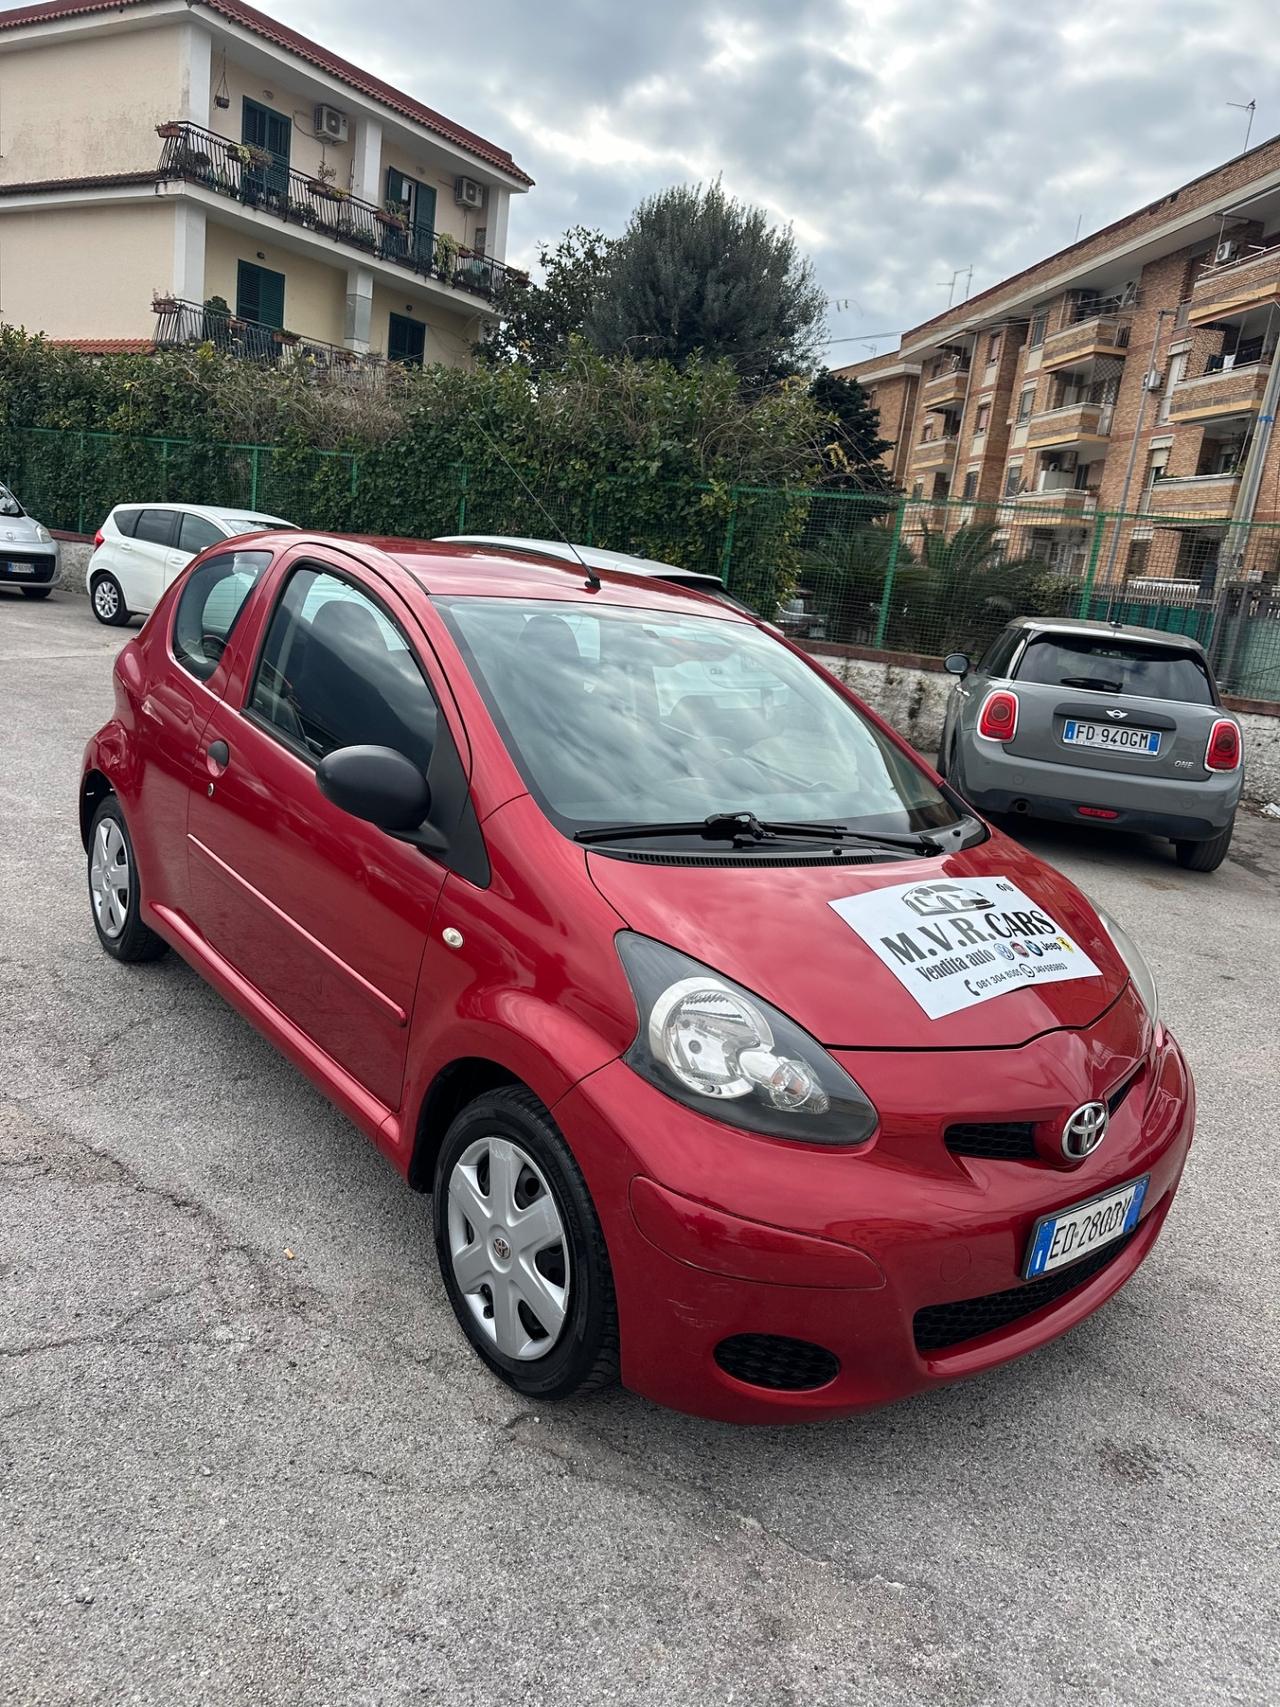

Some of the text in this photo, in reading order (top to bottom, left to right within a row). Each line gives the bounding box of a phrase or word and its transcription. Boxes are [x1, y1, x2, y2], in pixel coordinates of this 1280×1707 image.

[1076, 724, 1095, 740] FD
[1101, 728, 1149, 748] 940GM
[1174, 760, 1194, 769] ONE
[1040, 941, 1062, 951] Jeep
[917, 949, 996, 982] Vendita auto
[976, 979, 991, 989] 081
[990, 973, 1007, 984] 304
